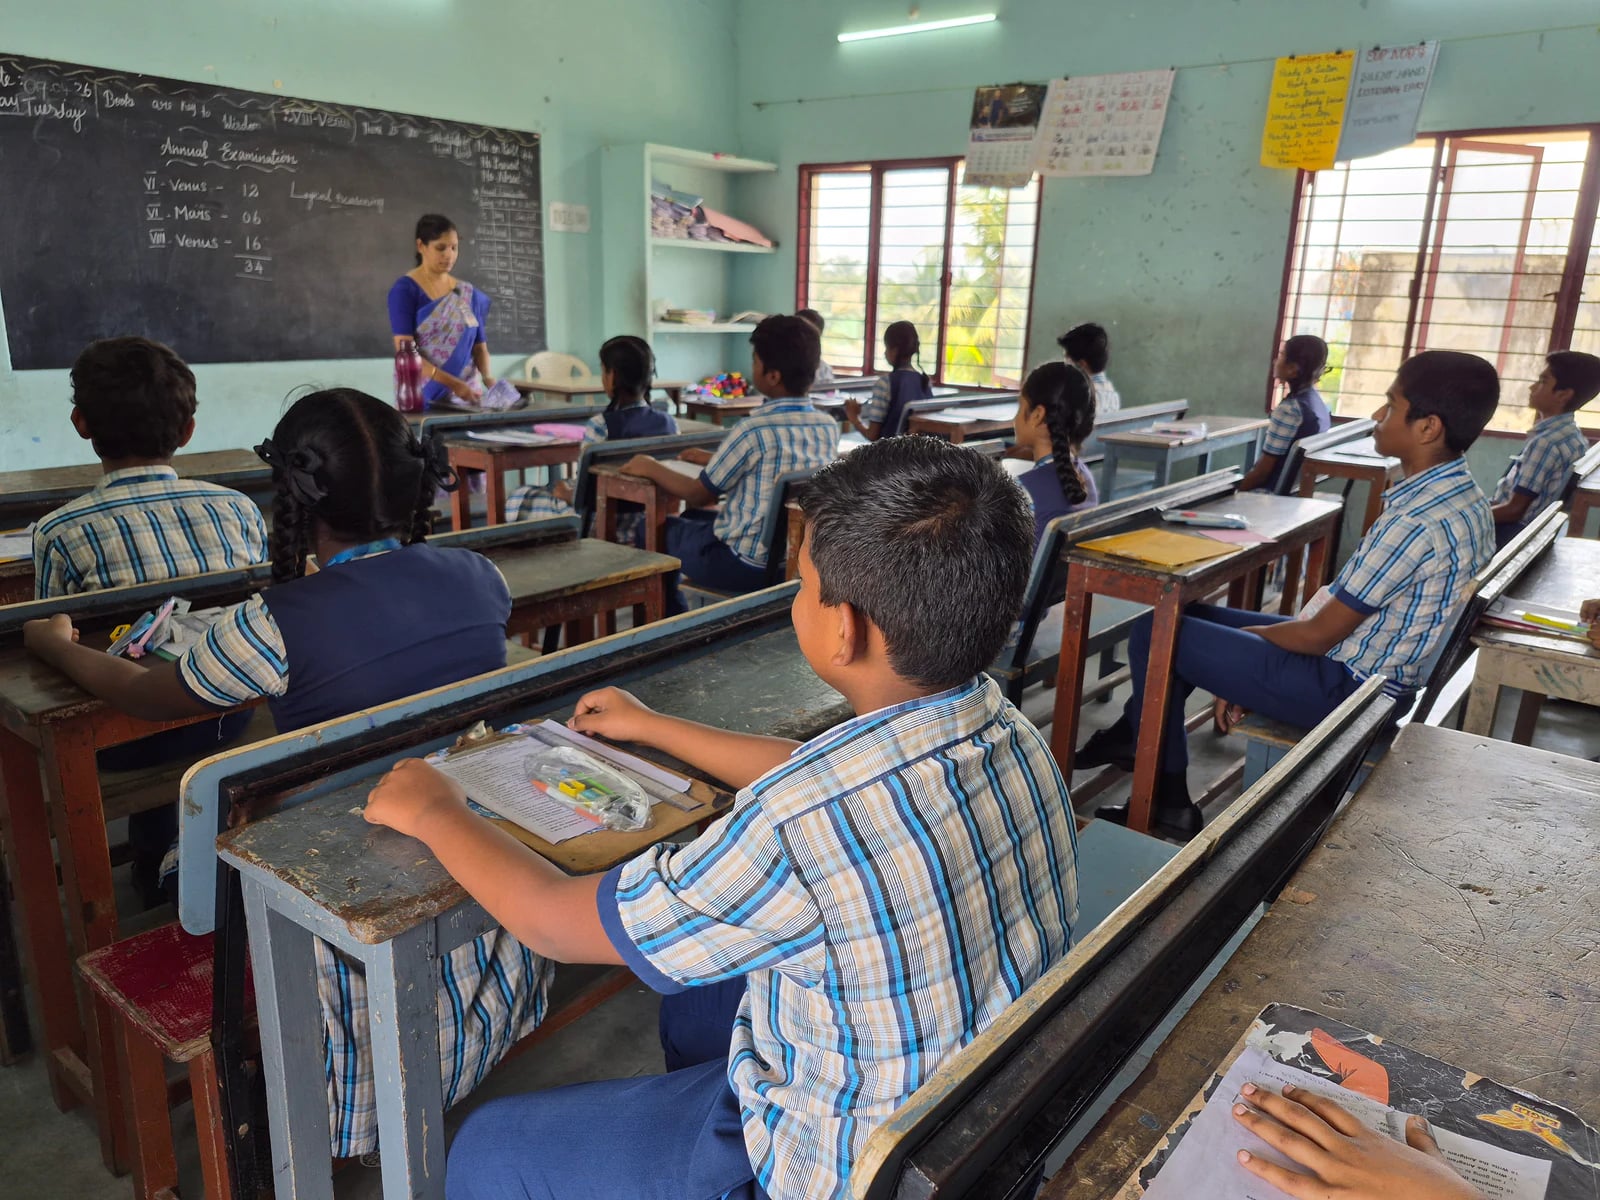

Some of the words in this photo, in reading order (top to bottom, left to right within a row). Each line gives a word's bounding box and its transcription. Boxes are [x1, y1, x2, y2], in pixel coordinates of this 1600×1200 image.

[0, 96, 20, 113] ay
[21, 97, 87, 133] Tuesday
[103, 89, 135, 108] Books
[201, 106, 212, 118] to
[161, 137, 209, 160] Annual
[218, 141, 299, 165] Examination
[169, 178, 208, 192] Venus
[242, 183, 259, 198] 12
[173, 204, 211, 222] Mars
[242, 210, 262, 225] 06
[175, 233, 219, 249] Venus
[245, 235, 262, 251] 16
[244, 259, 264, 275] 34
[1513, 1104, 1559, 1127] EAGLE
